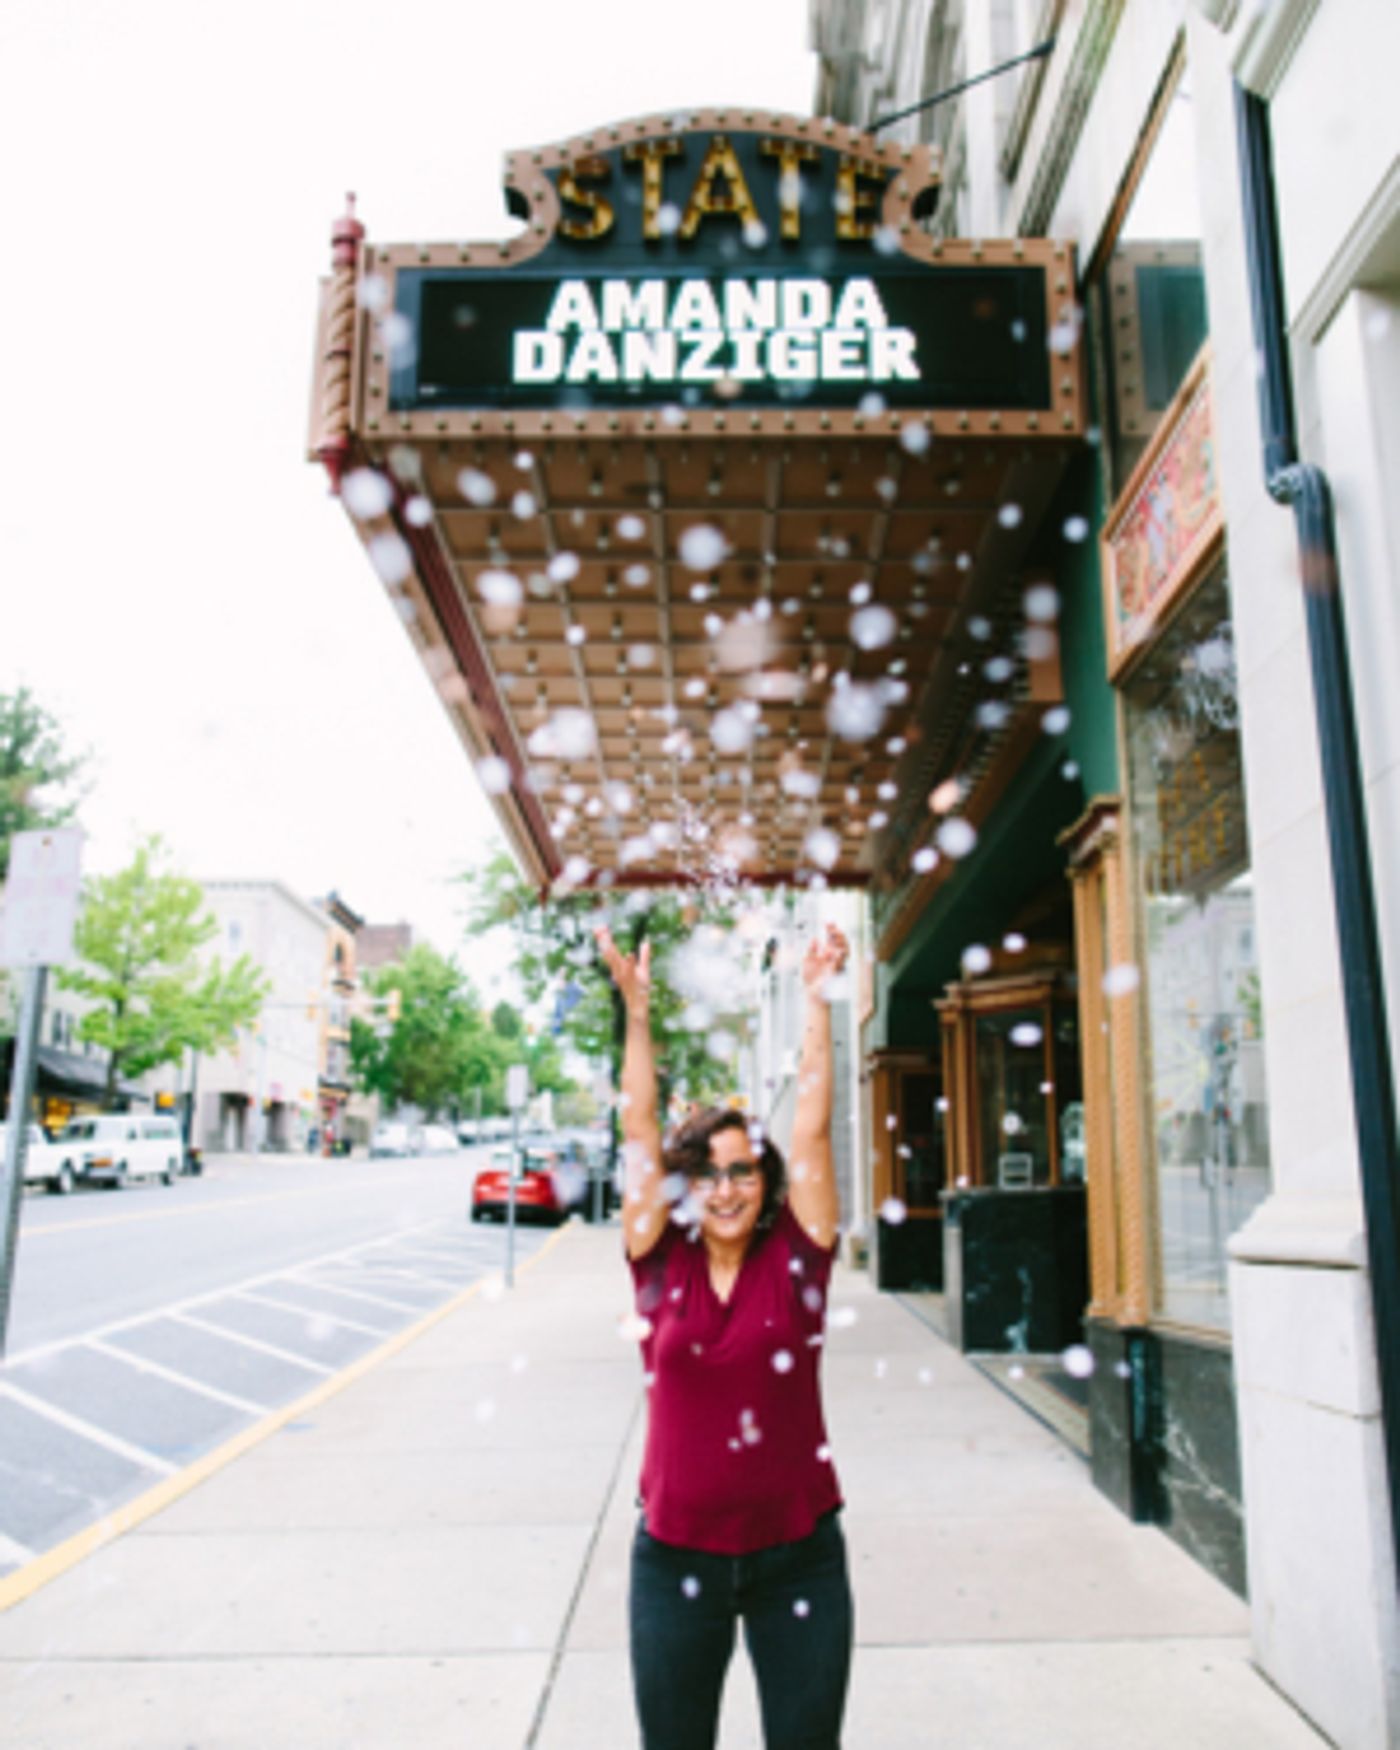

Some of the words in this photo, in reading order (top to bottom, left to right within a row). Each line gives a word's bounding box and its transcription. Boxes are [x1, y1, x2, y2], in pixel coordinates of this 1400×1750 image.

[556, 135, 885, 240] STATE
[545, 278, 888, 330] AMANDA
[513, 328, 921, 382] DANZIGER
